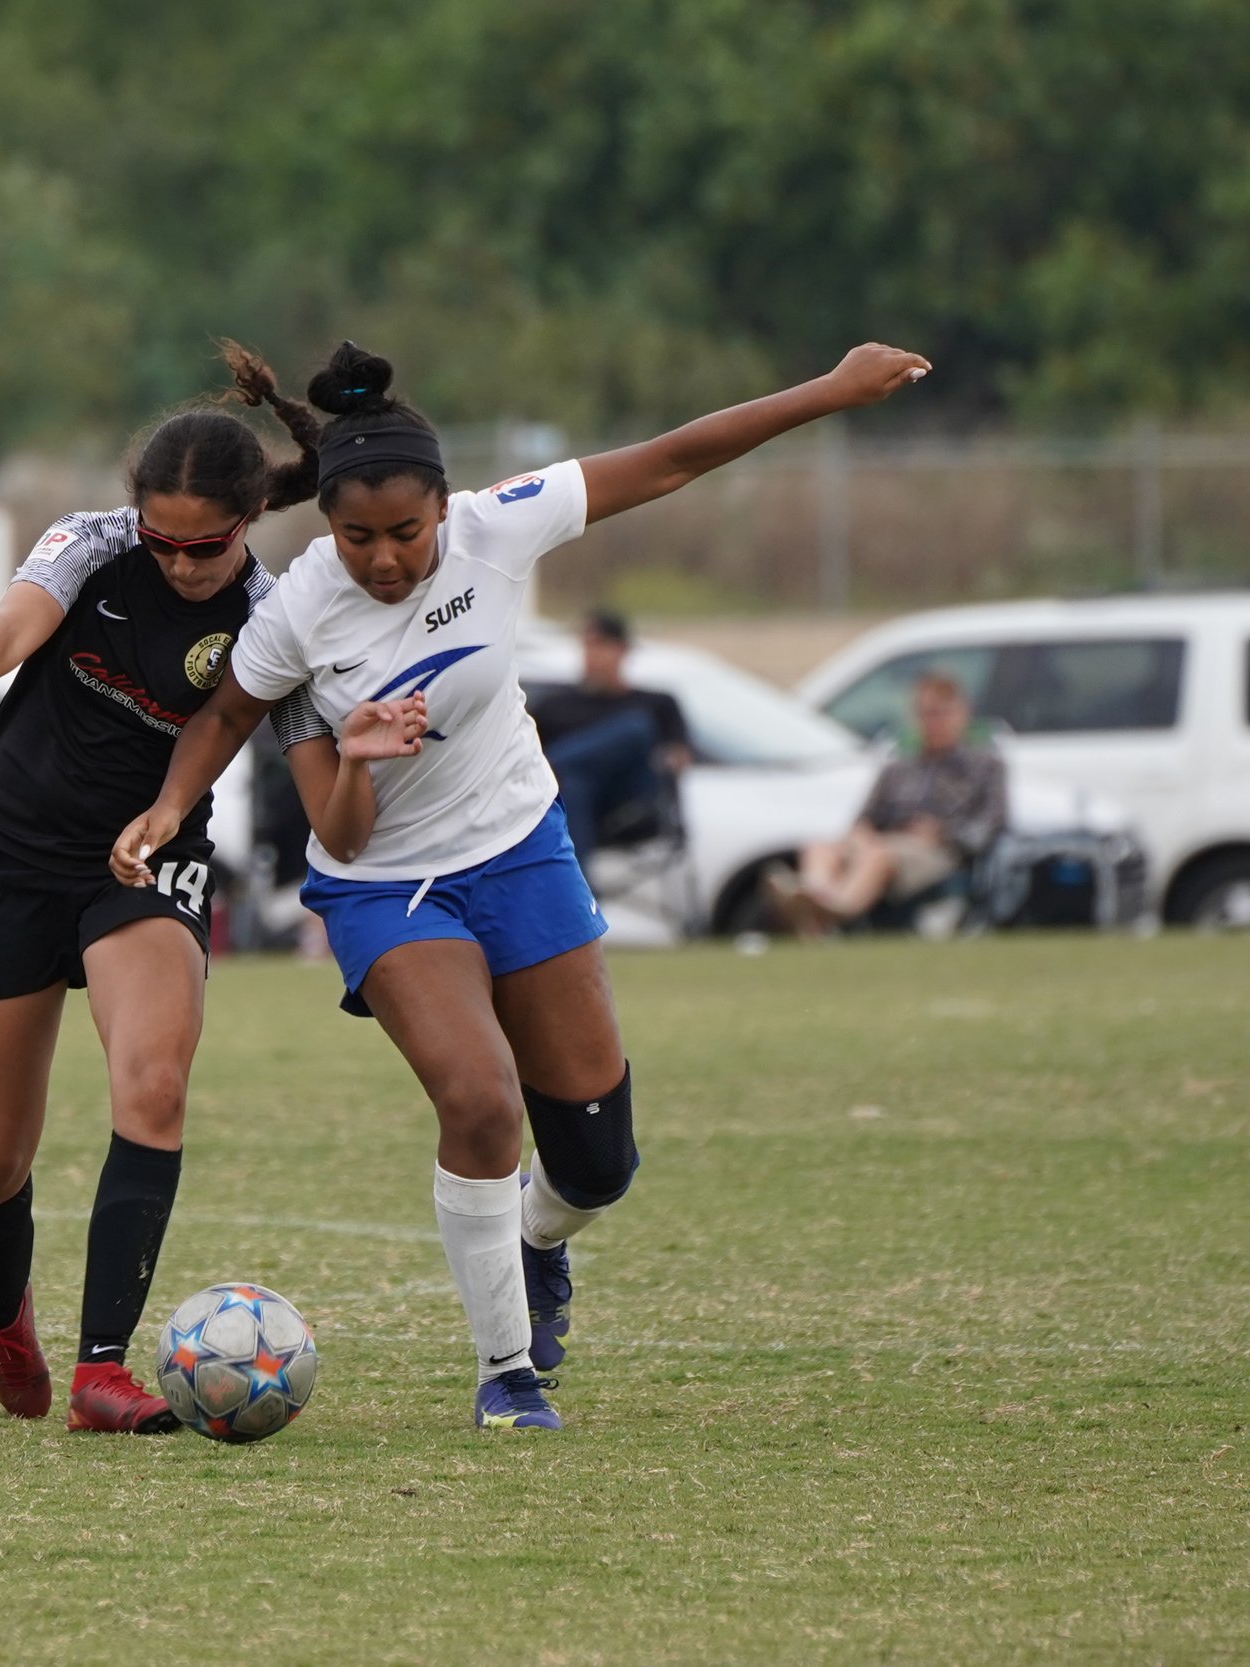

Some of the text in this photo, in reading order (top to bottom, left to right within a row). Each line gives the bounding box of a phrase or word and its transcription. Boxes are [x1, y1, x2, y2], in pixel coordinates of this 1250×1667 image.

[425, 587, 475, 633] SURF
[198, 635, 222, 649] SOCAL
[69, 658, 183, 738] TRANSMISSIO
[71, 652, 191, 726] Californi
[157, 861, 208, 915] 14
